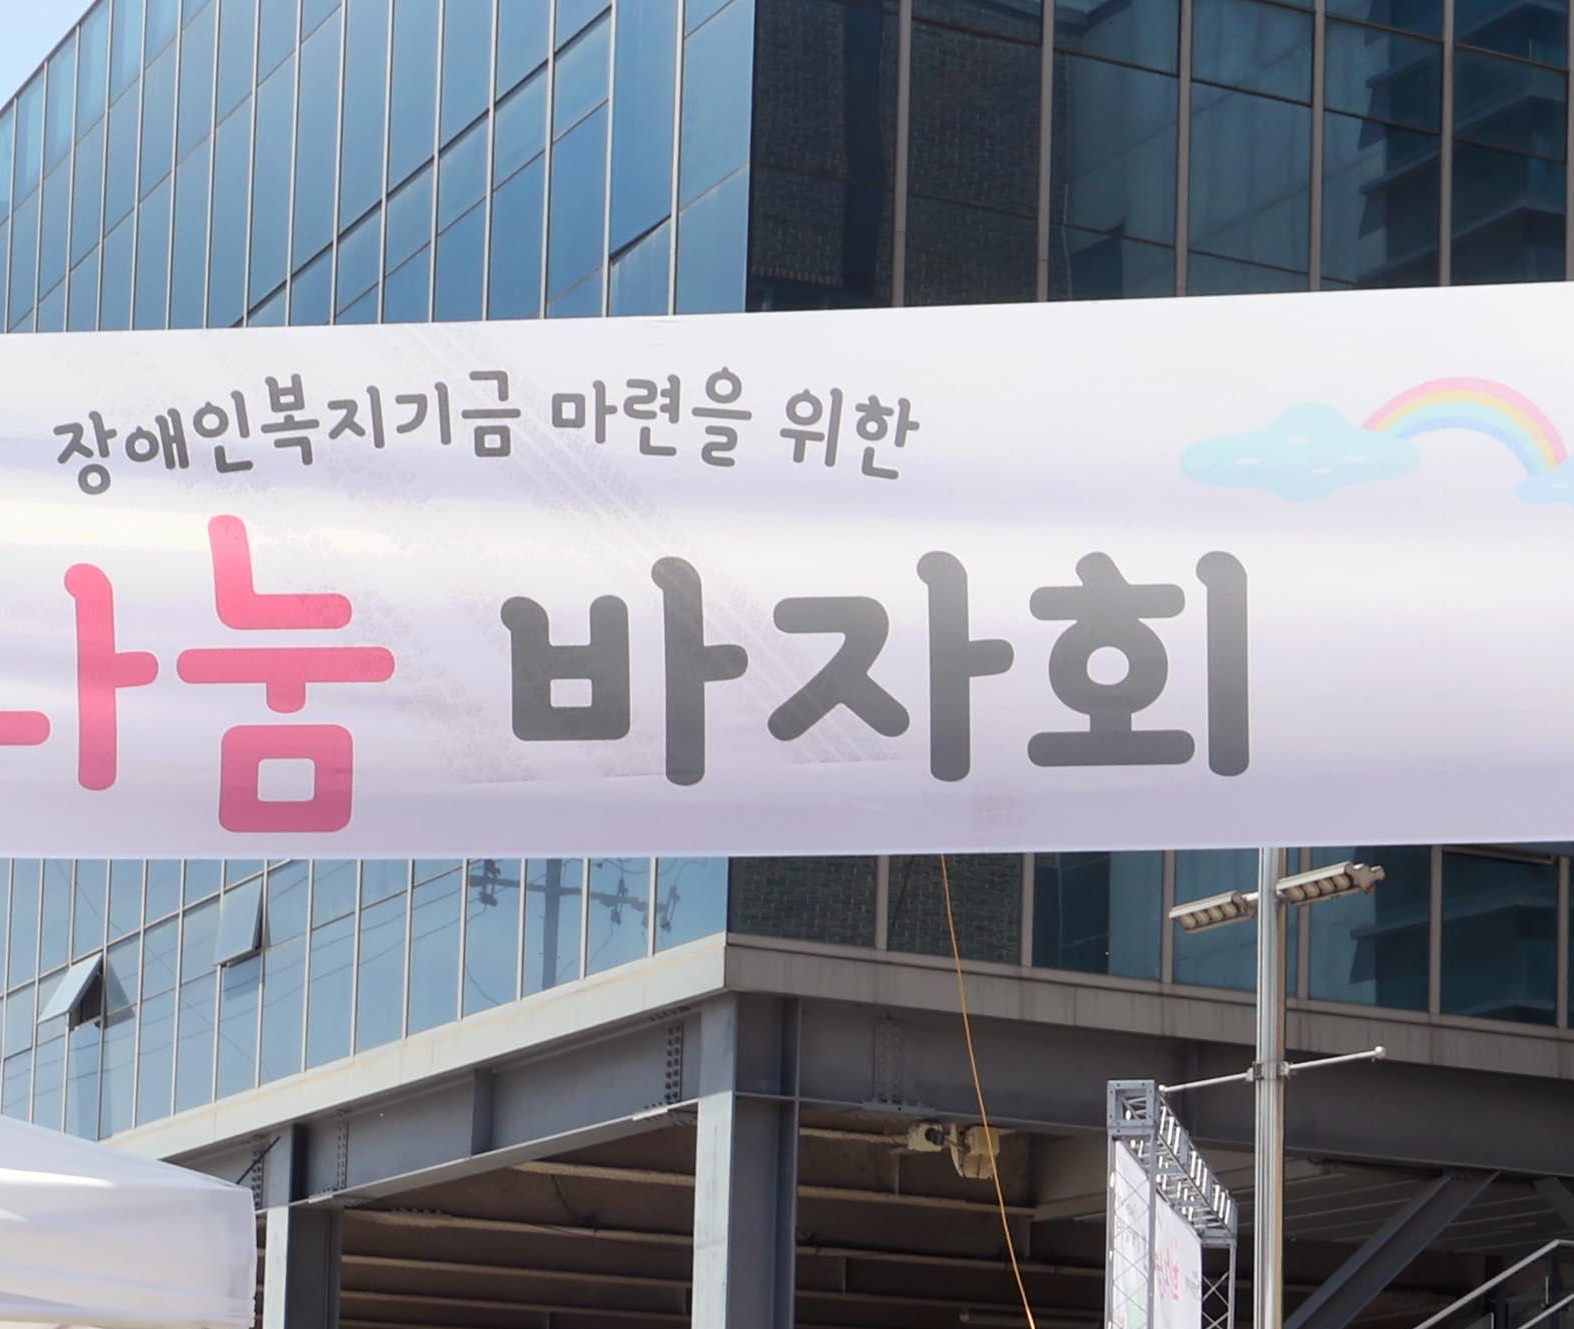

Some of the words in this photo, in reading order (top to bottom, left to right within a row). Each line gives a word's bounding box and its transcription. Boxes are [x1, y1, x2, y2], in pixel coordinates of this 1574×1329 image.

[52, 369, 522, 496] 장애인복지기금
[550, 368, 753, 468] 마련을
[779, 388, 921, 481] 위한
[499, 555, 1251, 788] 바자회
